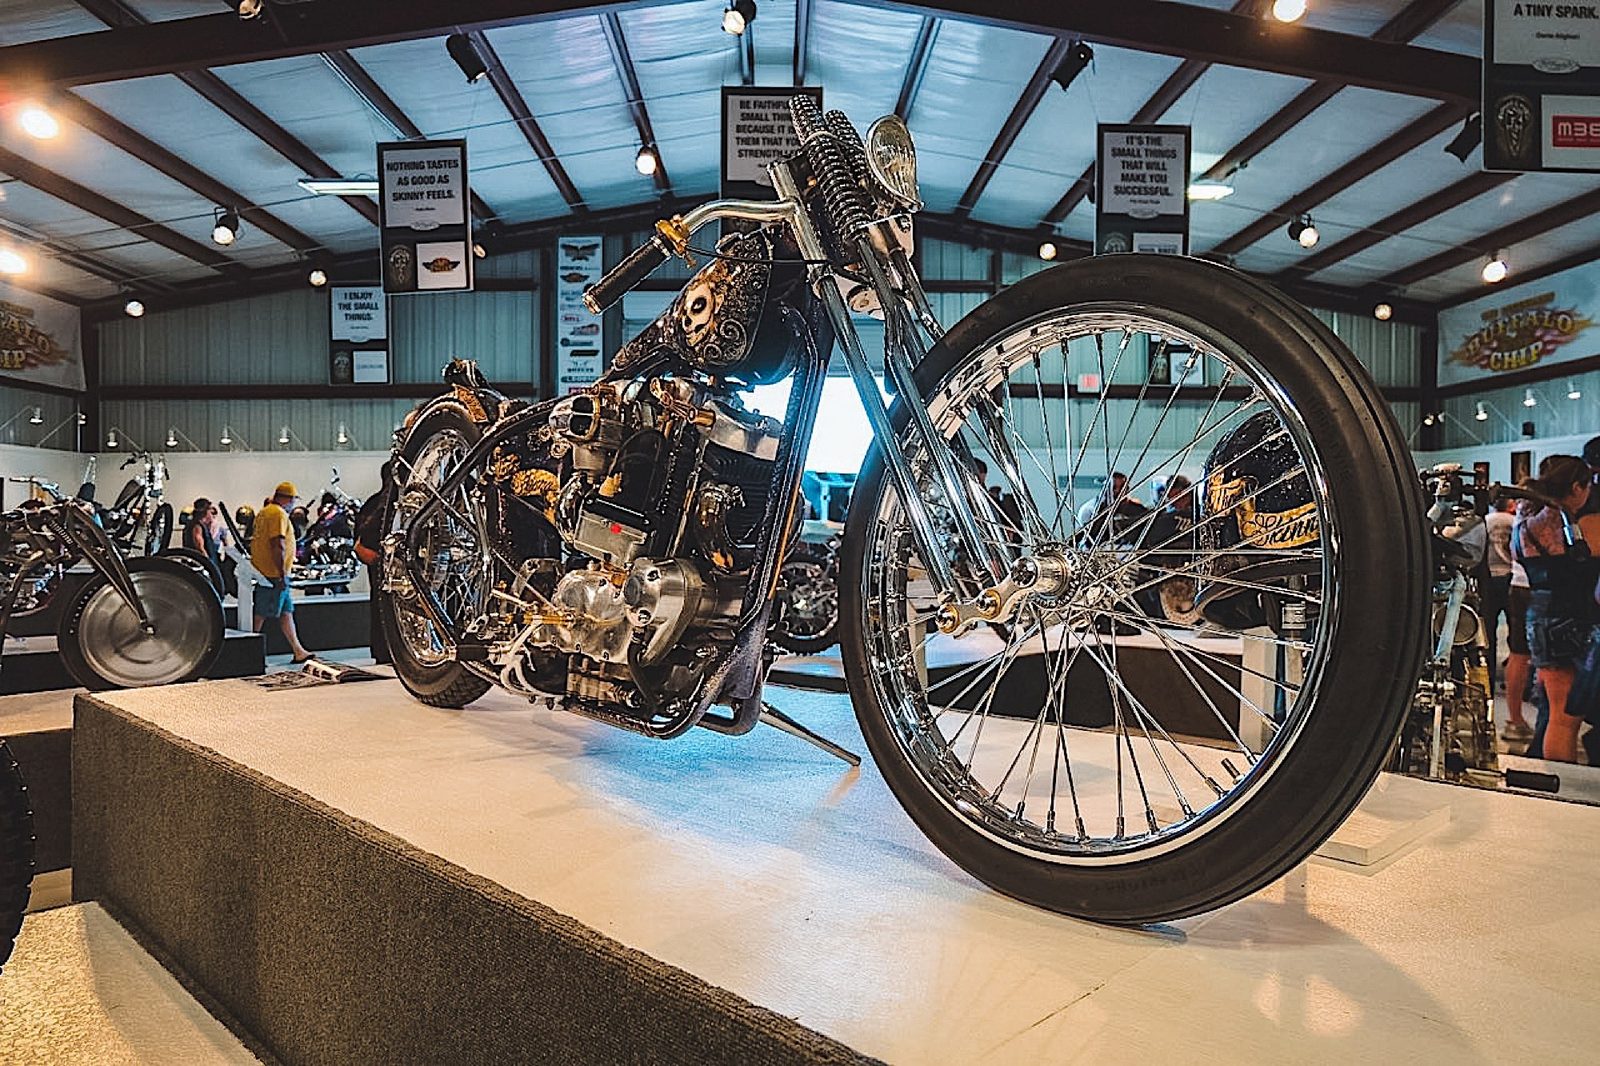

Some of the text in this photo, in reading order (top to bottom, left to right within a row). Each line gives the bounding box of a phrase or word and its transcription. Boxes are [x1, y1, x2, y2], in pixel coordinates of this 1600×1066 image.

[1513, 3, 1599, 19] A TINY SPARK.
[740, 100, 751, 109] BE
[740, 112, 770, 121] SMALL
[736, 124, 775, 134] BECAUSE
[777, 124, 785, 134] IT
[736, 137, 760, 146] THEM
[761, 137, 783, 146] THAT
[1126, 135, 1162, 146] IT'S THE
[1111, 147, 1177, 159] SMALL THINGS
[386, 159, 459, 171] NOTHING TASTES
[1121, 160, 1167, 171] THAT WILL
[397, 174, 450, 186] AS GOOD AS
[1121, 173, 1168, 184] MAKE YOU
[392, 190, 455, 201] SKINNY FEELS.
[1113, 185, 1174, 196] SUCCESSFUL.
[350, 292, 373, 300] ENJOY
[338, 302, 379, 310] THE SMALL
[1489, 341, 1544, 371] CHIP
